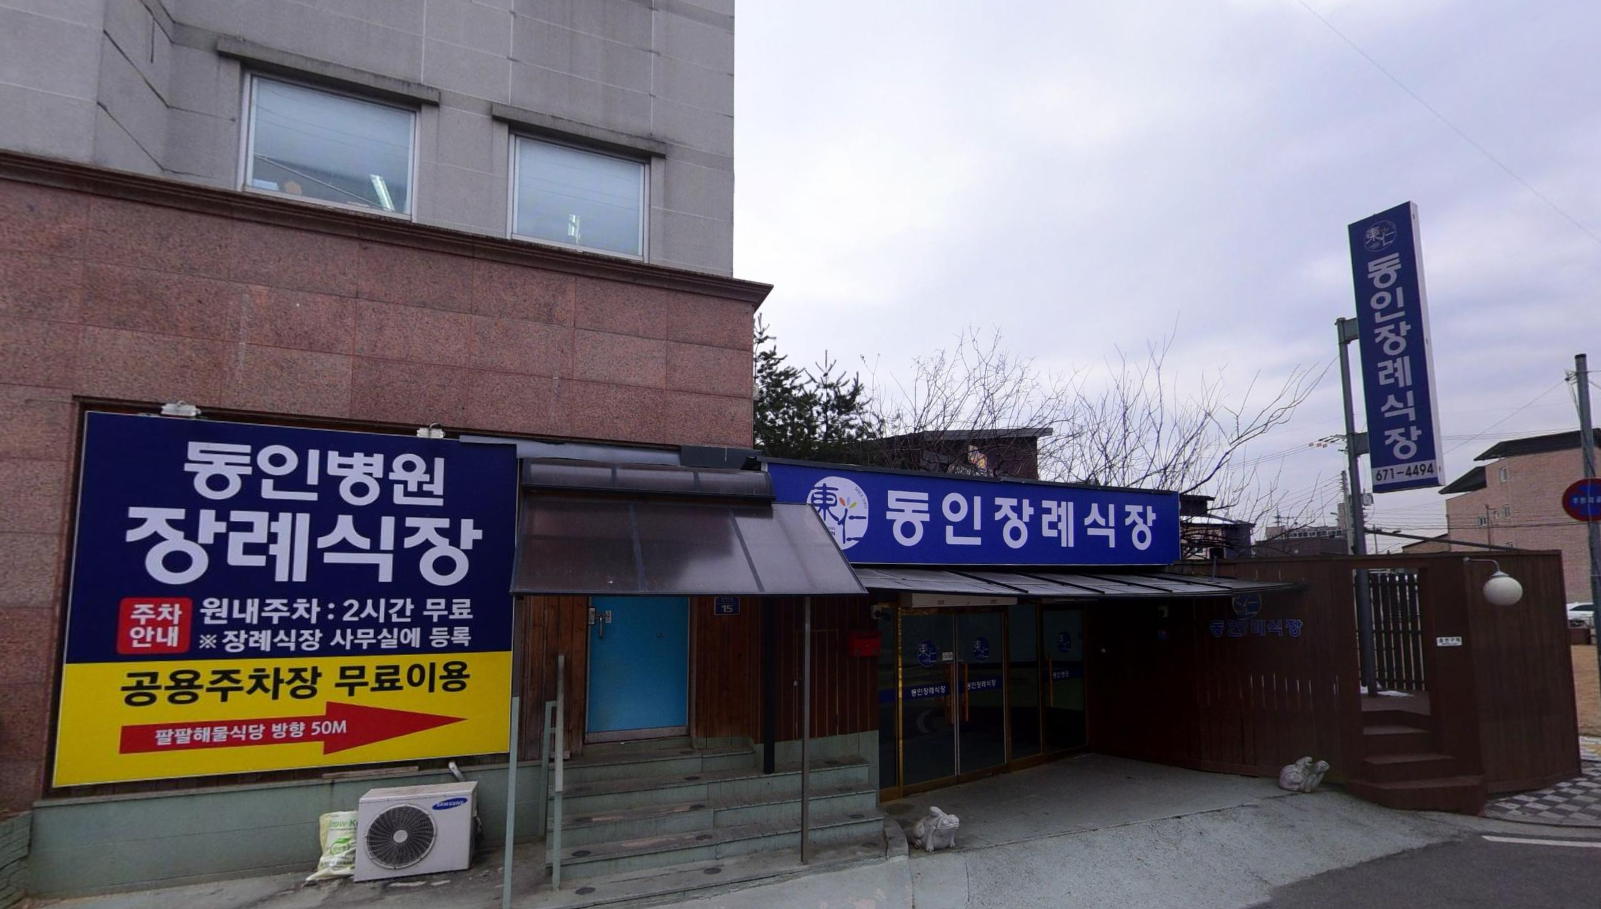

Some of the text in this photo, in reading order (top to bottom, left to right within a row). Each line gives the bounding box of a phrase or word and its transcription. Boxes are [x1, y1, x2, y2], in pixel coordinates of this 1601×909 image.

[1367, 252, 1422, 460] 동인장례식장
[183, 440, 445, 507] 동인병원
[1375, 461, 1435, 482] 671-4494
[885, 489, 1157, 551] 동인장례식장
[125, 506, 483, 586] 장례식장
[131, 603, 182, 625] 주차
[422, 598, 474, 622] 무료
[720, 604, 734, 613] 15
[129, 626, 180, 648] 안내
[222, 628, 323, 653] 장례식장
[329, 627, 421, 650] 사무실에
[429, 626, 472, 648] 등록
[120, 660, 471, 707] 공용주차장 무료이용
[154, 720, 347, 746] 팔팔해물식당 방향 50M
